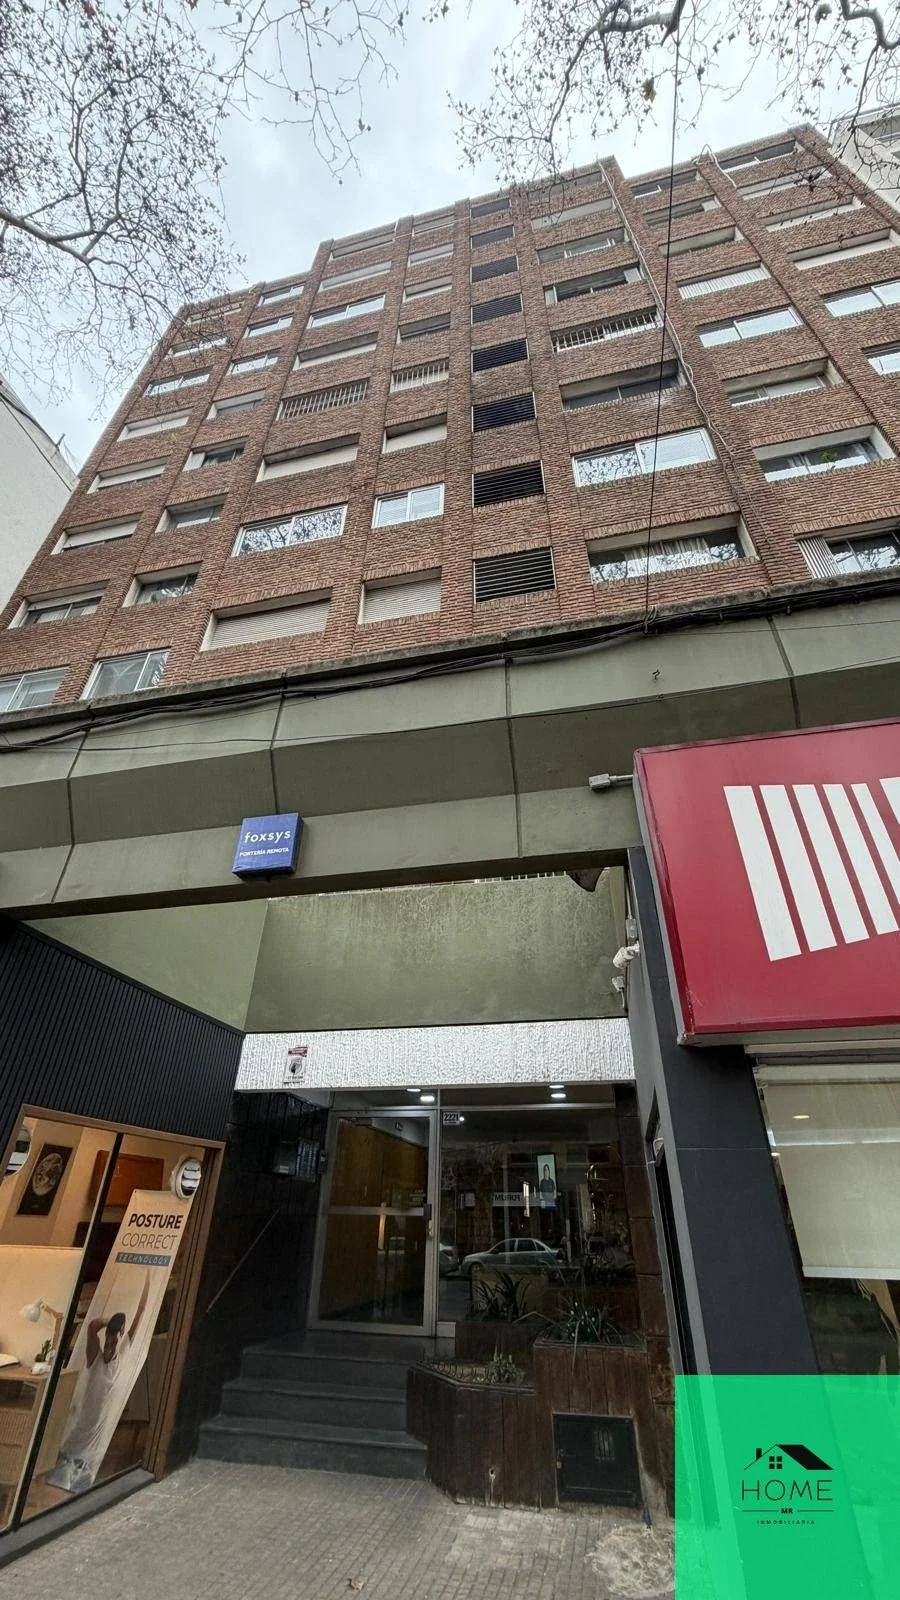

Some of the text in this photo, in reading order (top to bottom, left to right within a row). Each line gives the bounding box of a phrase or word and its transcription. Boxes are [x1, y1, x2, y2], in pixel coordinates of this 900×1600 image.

[244, 830, 291, 843] foxsys
[267, 847, 289, 855] REMOTA
[443, 1112, 459, 1121] 2221
[128, 1213, 184, 1229] POSTURE
[121, 1232, 178, 1249] CORRECT
[119, 1254, 169, 1265] TECHNOLOGY
